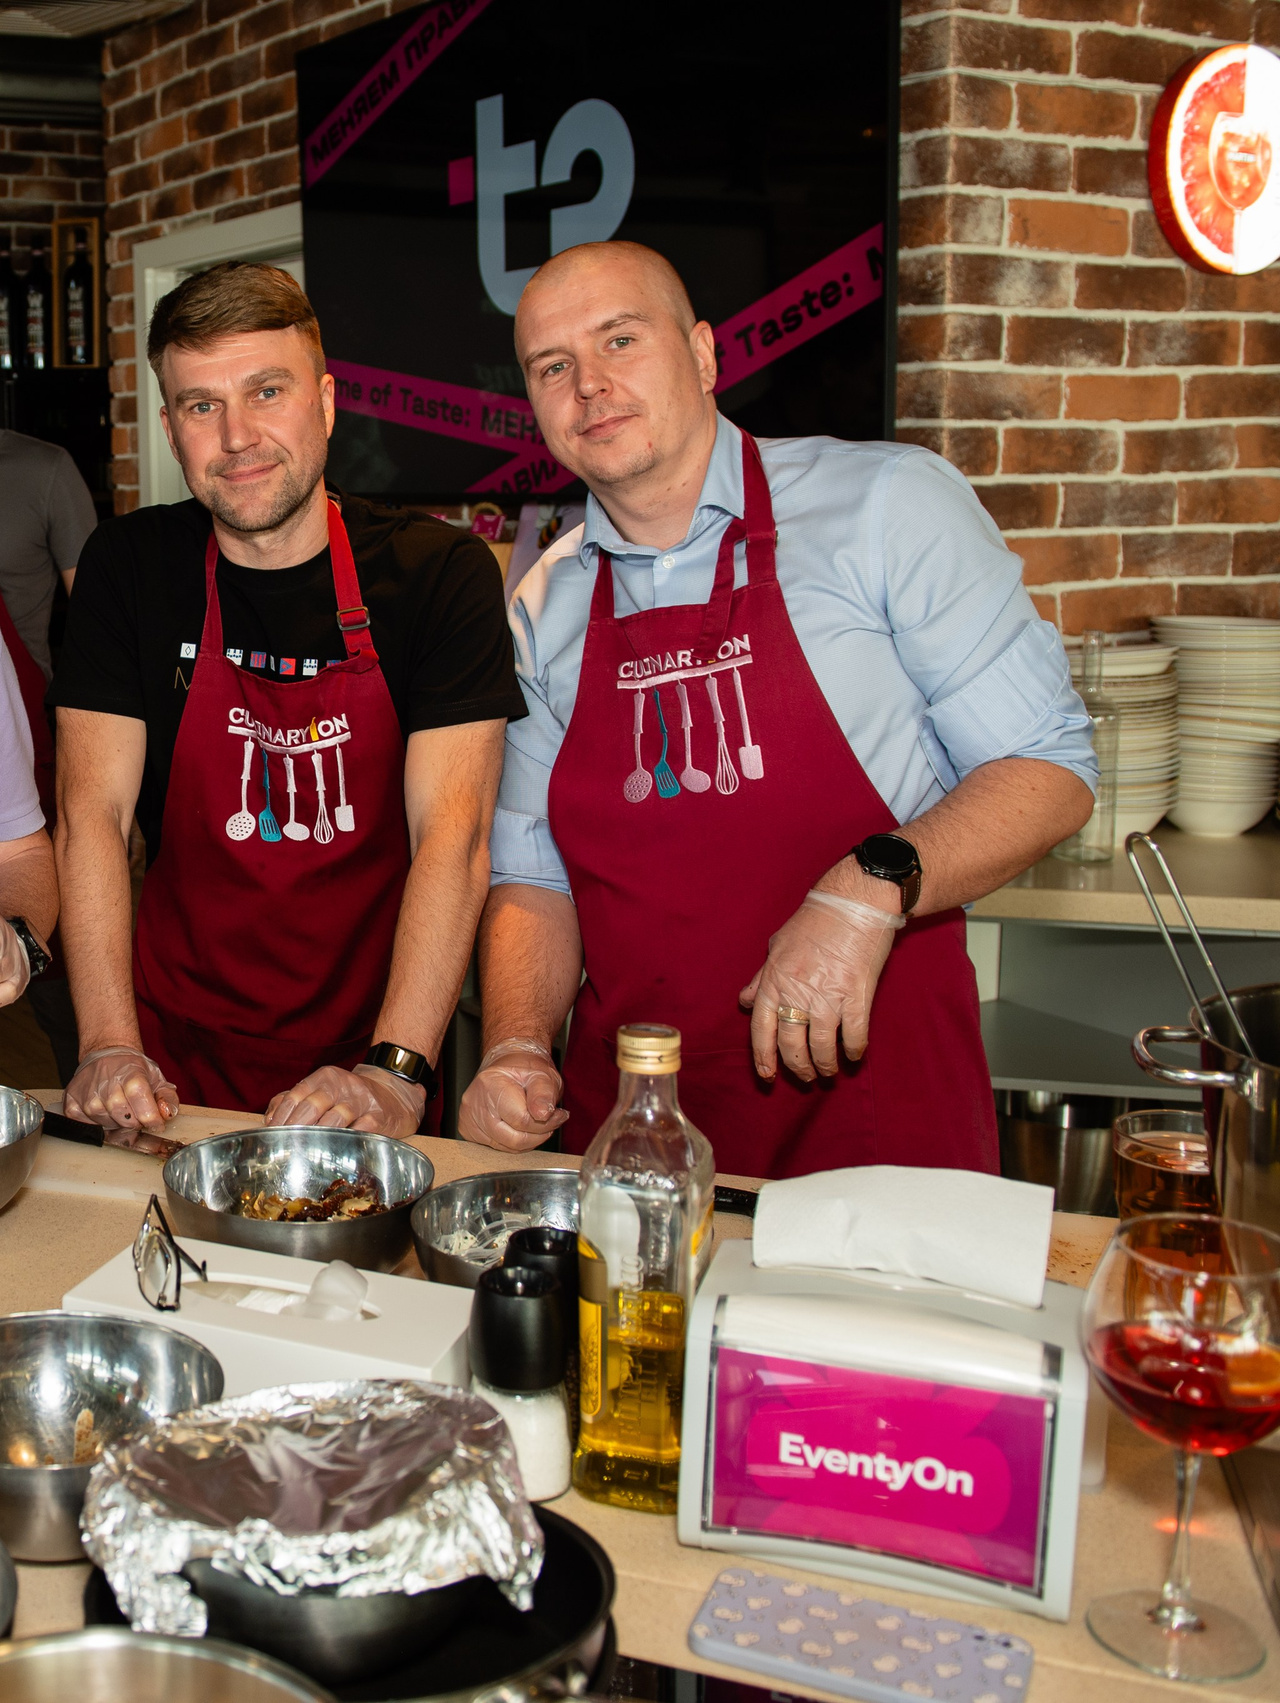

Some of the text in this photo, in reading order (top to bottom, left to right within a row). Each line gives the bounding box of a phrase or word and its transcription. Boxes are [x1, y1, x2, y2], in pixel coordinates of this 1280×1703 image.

[404, 0, 476, 70] ПРАВ
[735, 272, 854, 357] Taste:
[370, 382, 392, 406] of
[400, 386, 471, 428] Taste:
[779, 1431, 974, 1497] EventyOn
